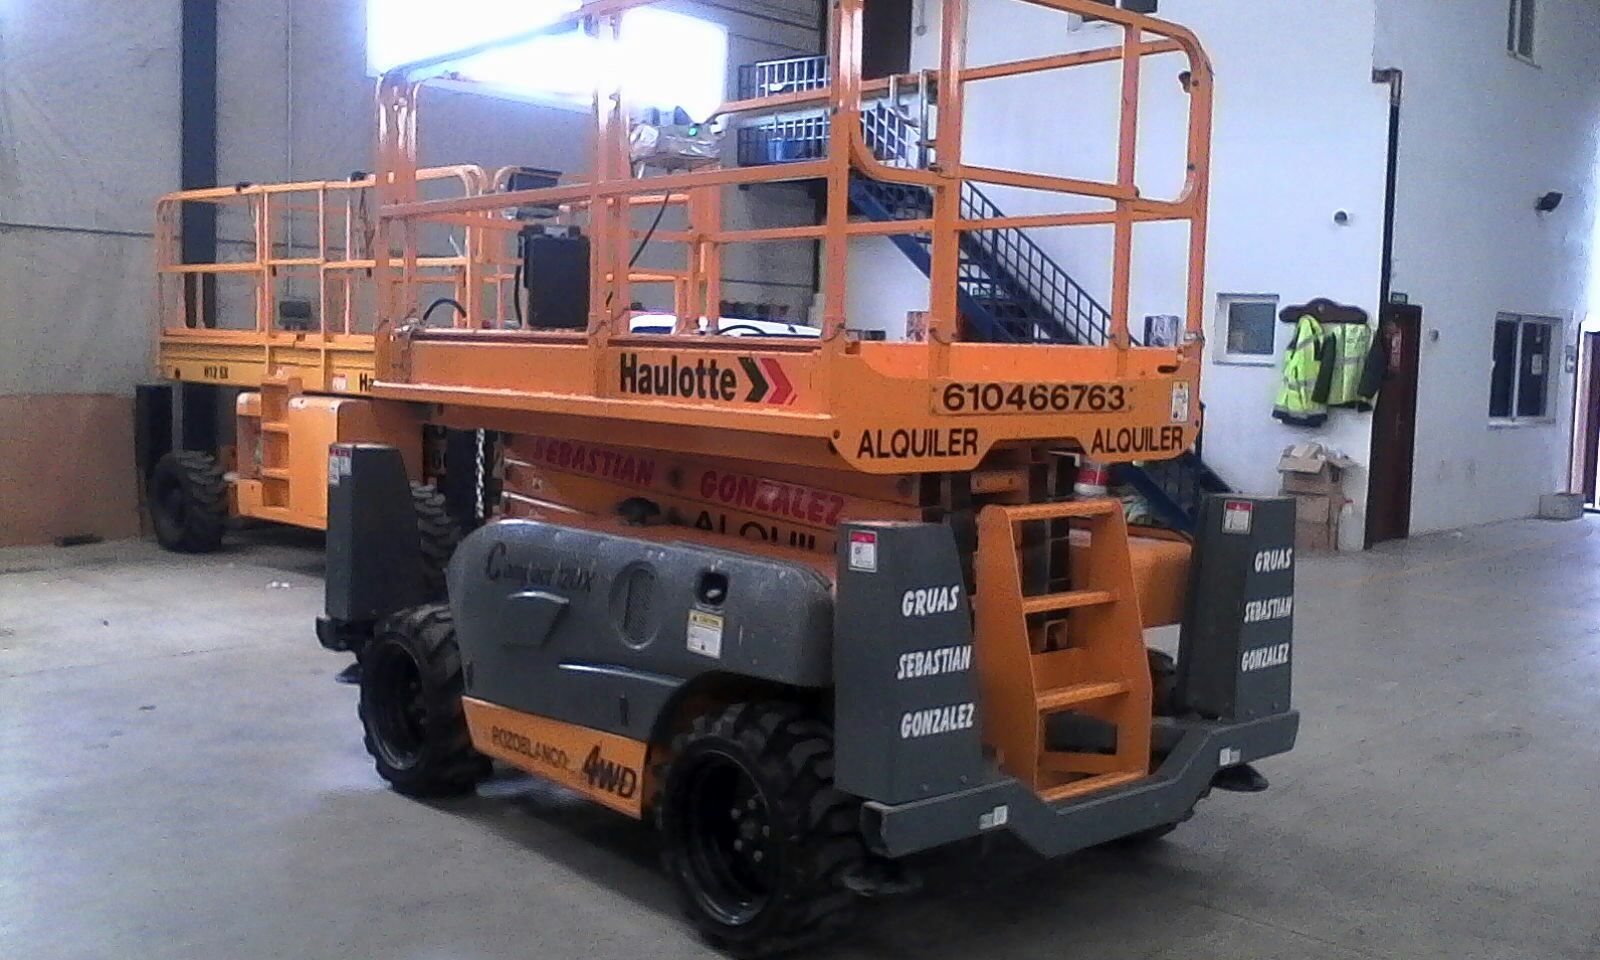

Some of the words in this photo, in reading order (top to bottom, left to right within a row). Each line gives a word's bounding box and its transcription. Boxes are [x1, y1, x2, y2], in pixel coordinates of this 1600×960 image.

[620, 352, 736, 402] Haulotte
[942, 382, 1126, 412] 610466763
[857, 427, 979, 459] ALQUILER
[1090, 425, 1184, 455] ALQUILER
[700, 470, 846, 524] GONZALEZ
[1254, 547, 1293, 574] GRUAS
[901, 585, 960, 617] GRUAS
[1243, 595, 1293, 624] SEBASTIAN
[896, 644, 972, 680] SEBASTIAN
[1241, 642, 1290, 673] GONZALEZ
[900, 702, 975, 739] GONZALEZ
[582, 742, 638, 799] 4WD
